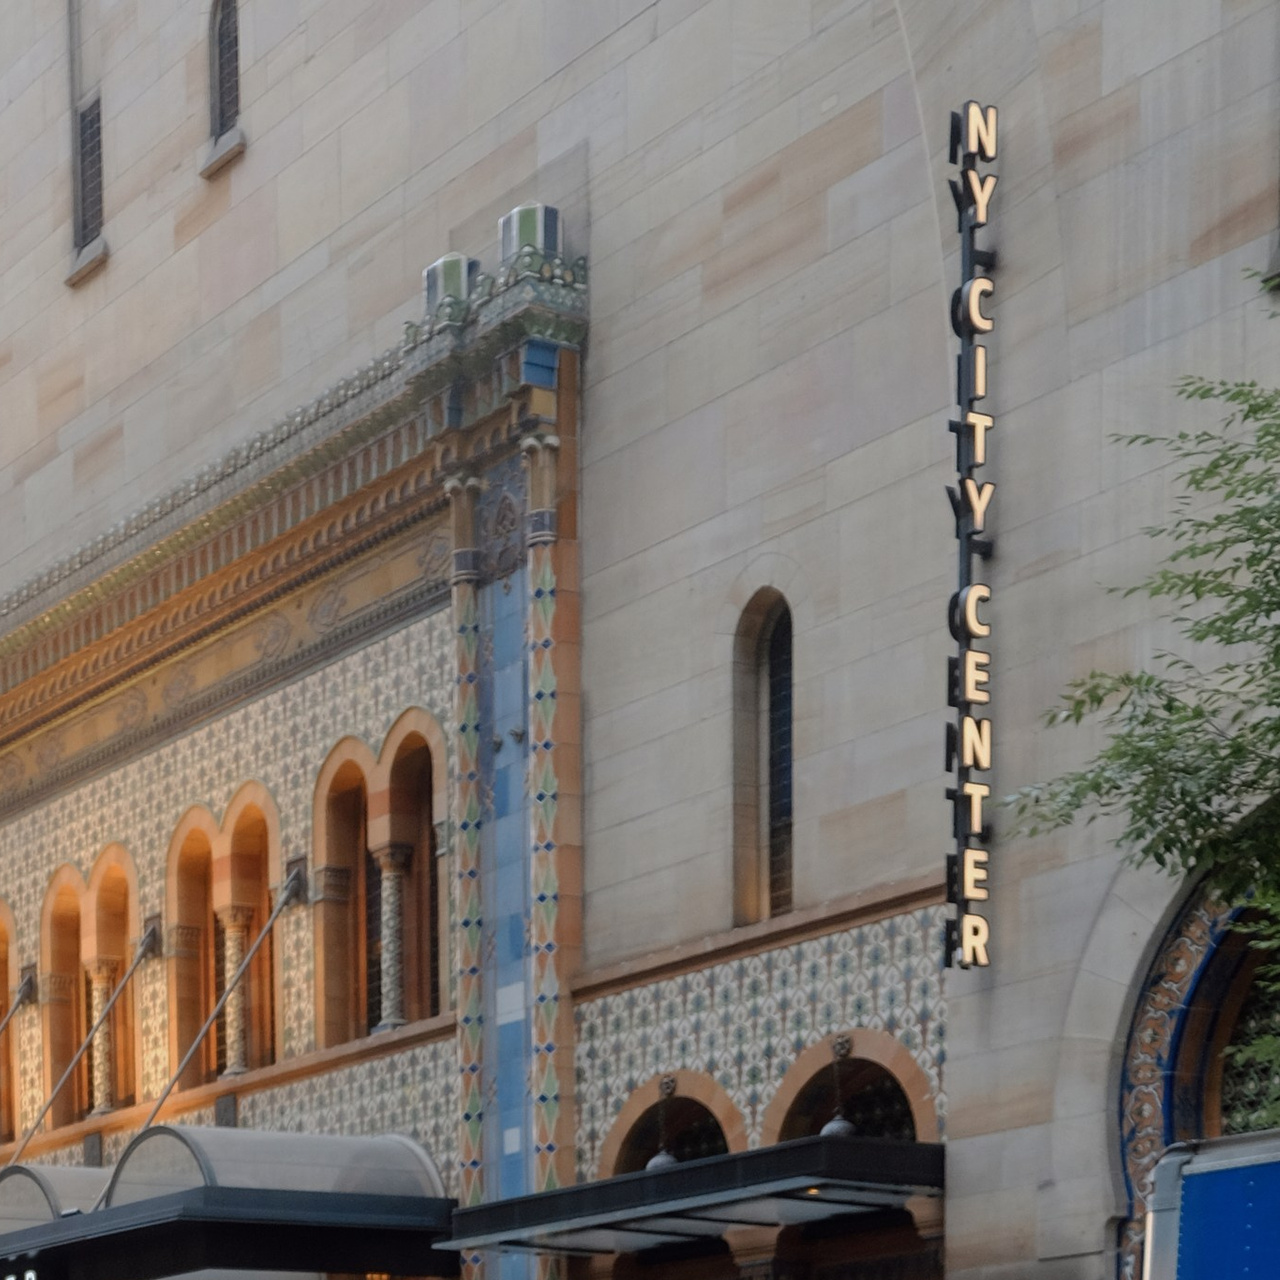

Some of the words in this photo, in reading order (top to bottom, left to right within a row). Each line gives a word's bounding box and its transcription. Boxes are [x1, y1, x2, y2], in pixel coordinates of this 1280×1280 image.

[963, 100, 998, 228] NY
[962, 276, 996, 534] CITY
[961, 584, 992, 967] CENTER
